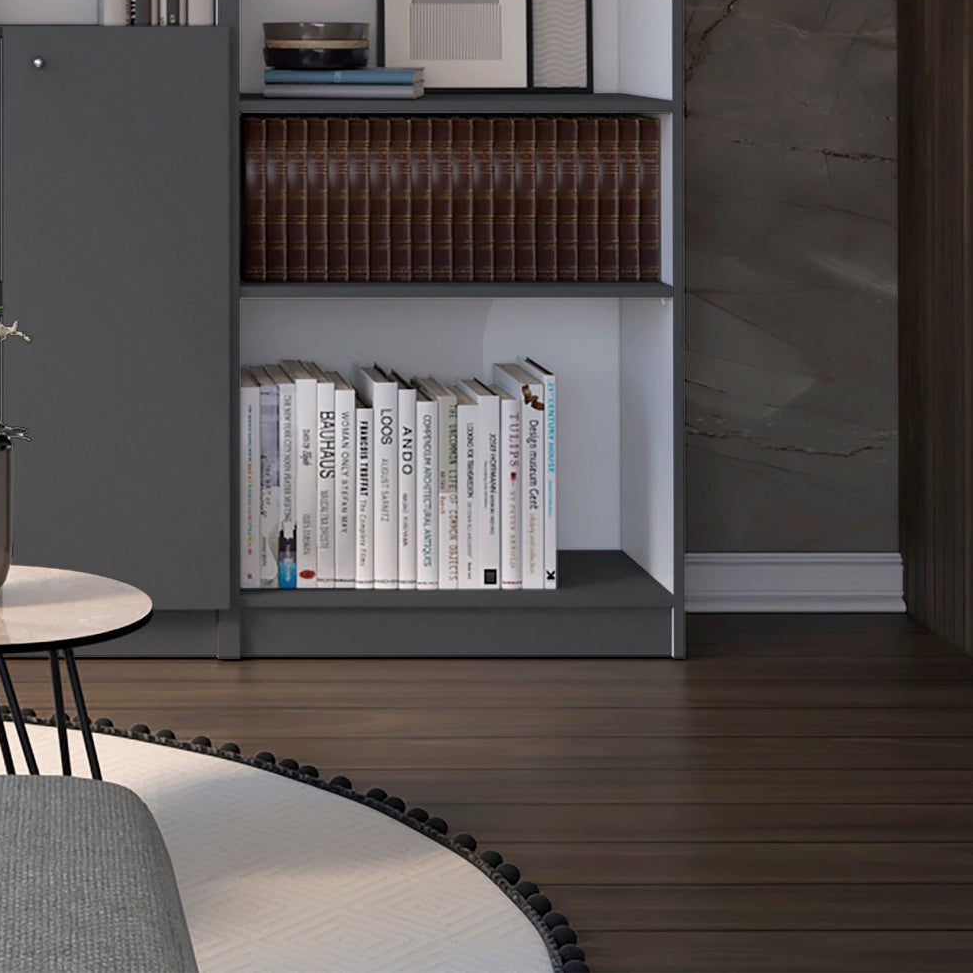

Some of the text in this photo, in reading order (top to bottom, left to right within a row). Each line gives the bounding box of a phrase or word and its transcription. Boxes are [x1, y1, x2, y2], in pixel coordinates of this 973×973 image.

[320, 411, 335, 478] BAUHAUS
[360, 421, 368, 460] FRANCOIS
[381, 408, 393, 445] LOOS
[402, 426, 412, 476] ANDO
[509, 412, 519, 467] TULIPS
[341, 411, 349, 534] WOMAN ONLY STEFAN MAY
[381, 458, 389, 488] AUGUST
[527, 419, 539, 510] Design museum Gent
[422, 467, 431, 527] ARCHITECTURAL
[449, 405, 458, 581] THE UNCOMMON LIFE OF COMMON OBJECTS
[358, 514, 367, 546] Complete
[422, 529, 431, 567] ANTIQUES
